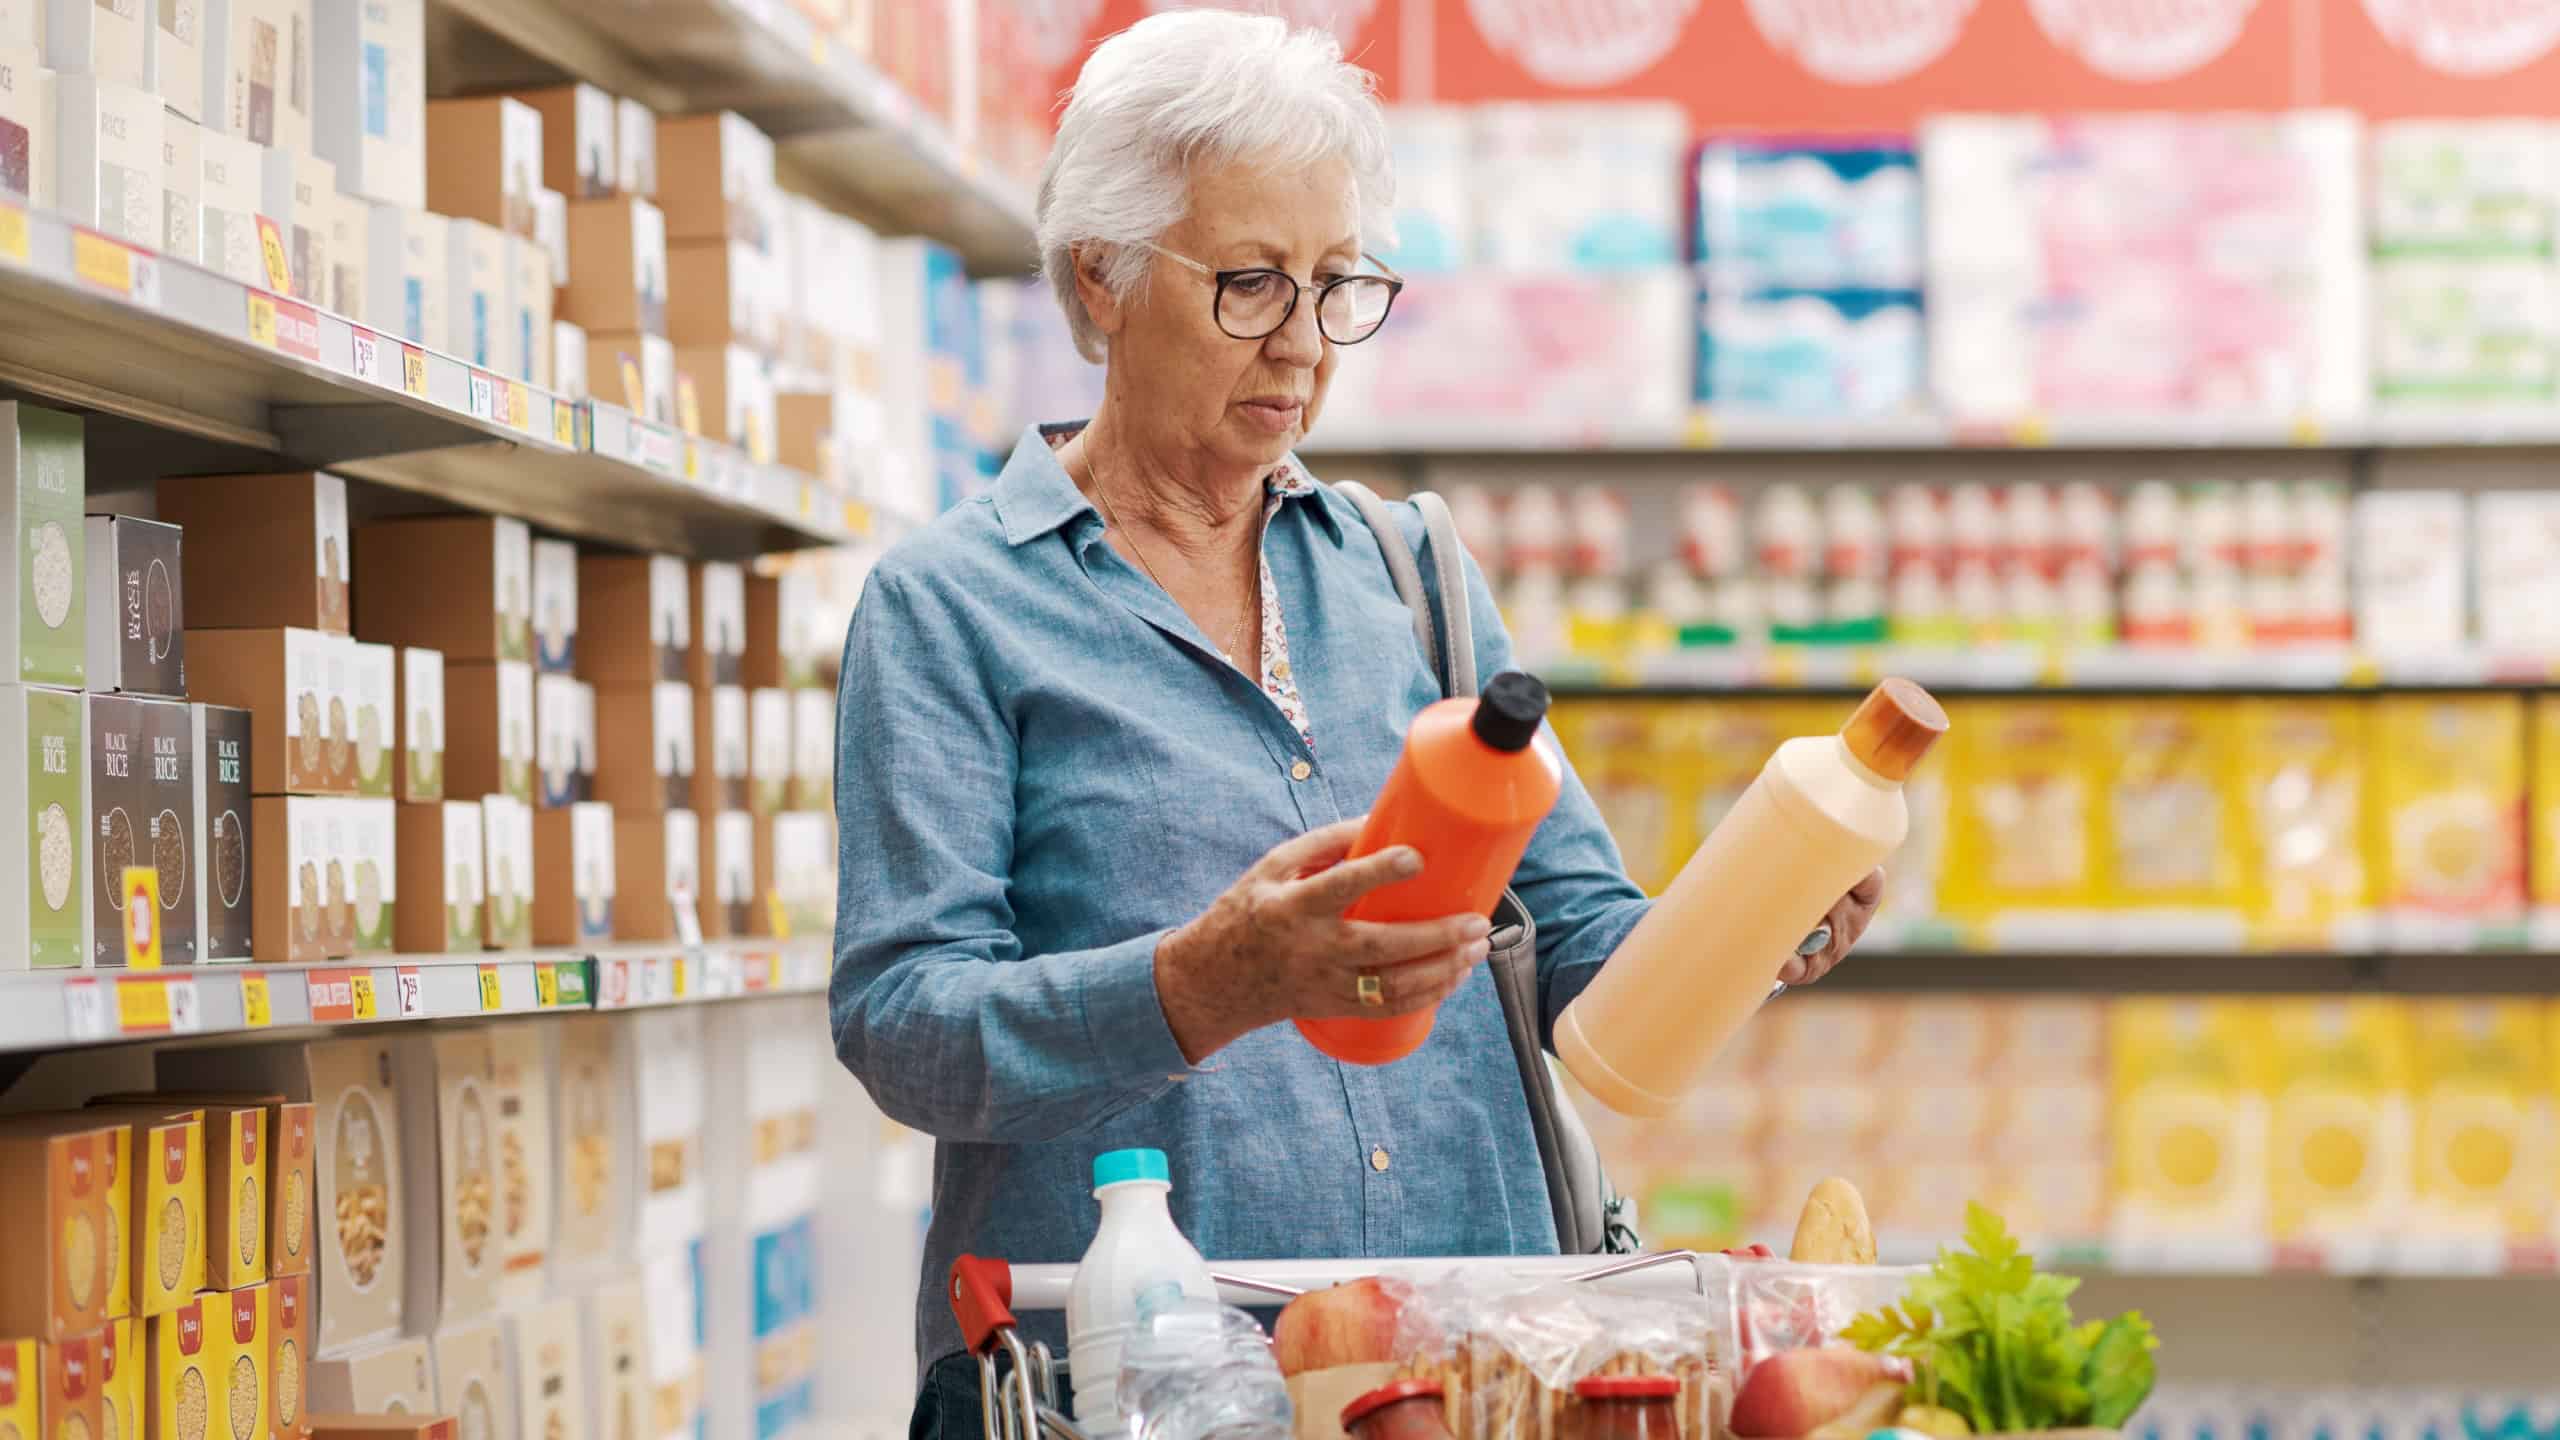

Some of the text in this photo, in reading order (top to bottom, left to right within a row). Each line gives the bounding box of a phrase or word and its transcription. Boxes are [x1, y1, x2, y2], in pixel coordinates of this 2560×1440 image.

[101, 112, 127, 140] RICE
[37, 464, 67, 494] RICE
[105, 732, 128, 751] BLACK
[154, 736, 177, 755] BLACK
[218, 740, 239, 758] BLACK
[43, 748, 67, 774] RICE
[106, 753, 129, 777] RICE
[154, 756, 178, 780] RICE
[219, 759, 240, 783] RICE
